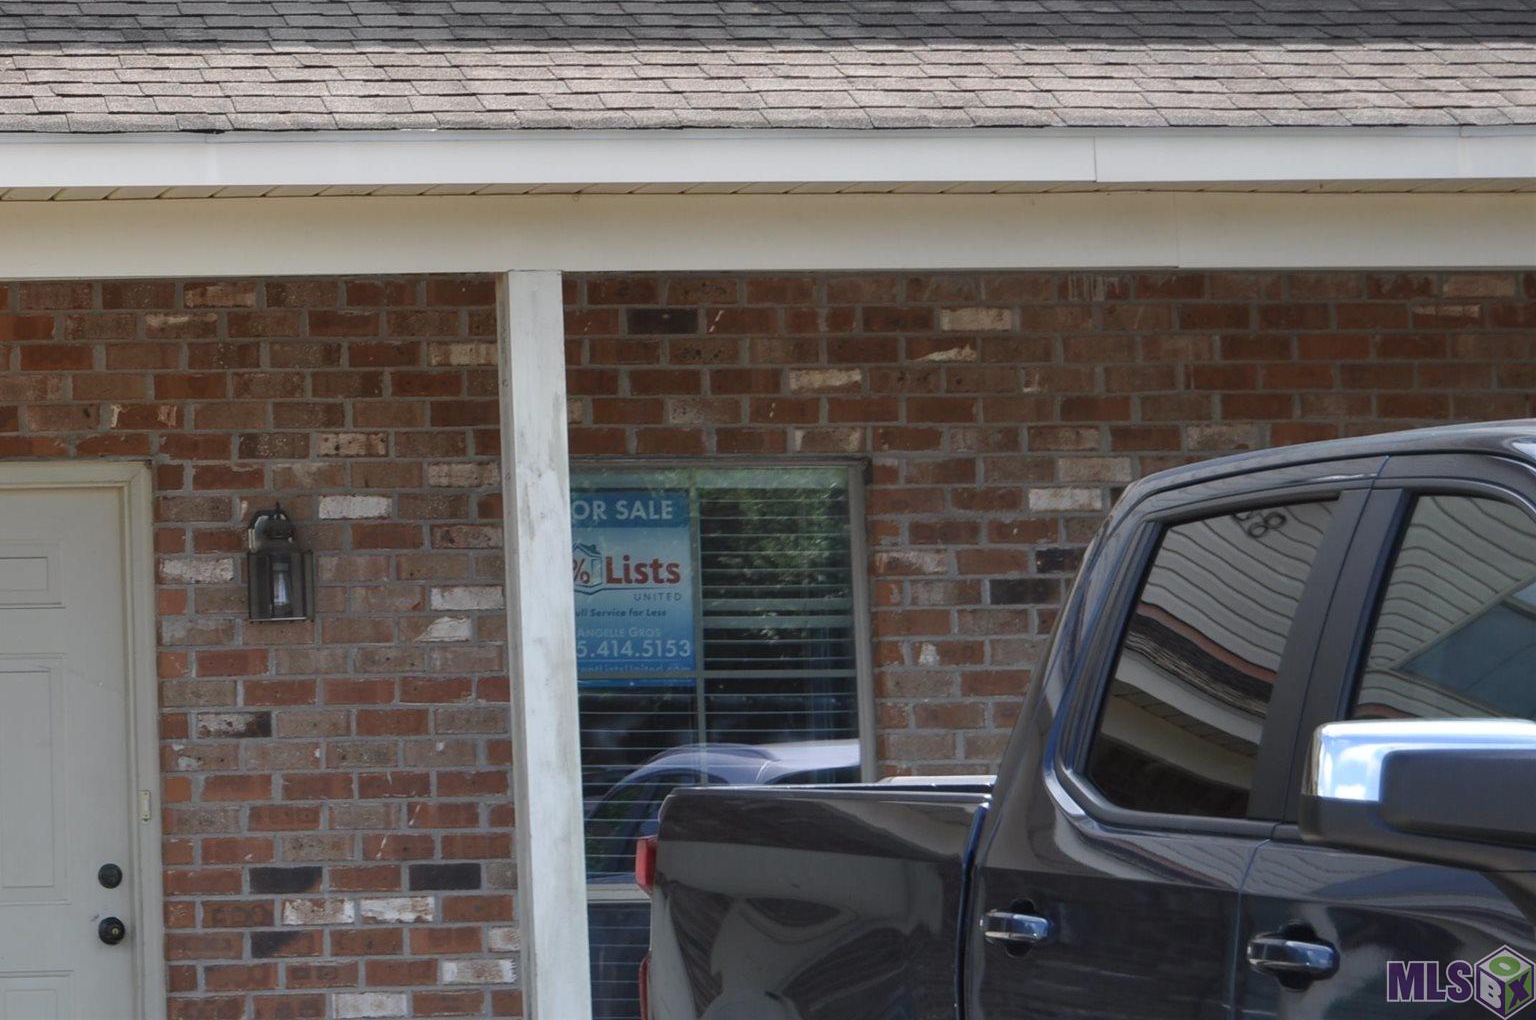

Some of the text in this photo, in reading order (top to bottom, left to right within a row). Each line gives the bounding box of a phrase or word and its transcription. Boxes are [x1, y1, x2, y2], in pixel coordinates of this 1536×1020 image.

[571, 499, 673, 520] OR SALE
[605, 554, 681, 585] Lists
[633, 592, 682, 601] UNITED
[590, 608, 625, 617] Service
[629, 607, 644, 617] for
[646, 608, 667, 617] Less
[576, 639, 692, 658] 5.414.5153
